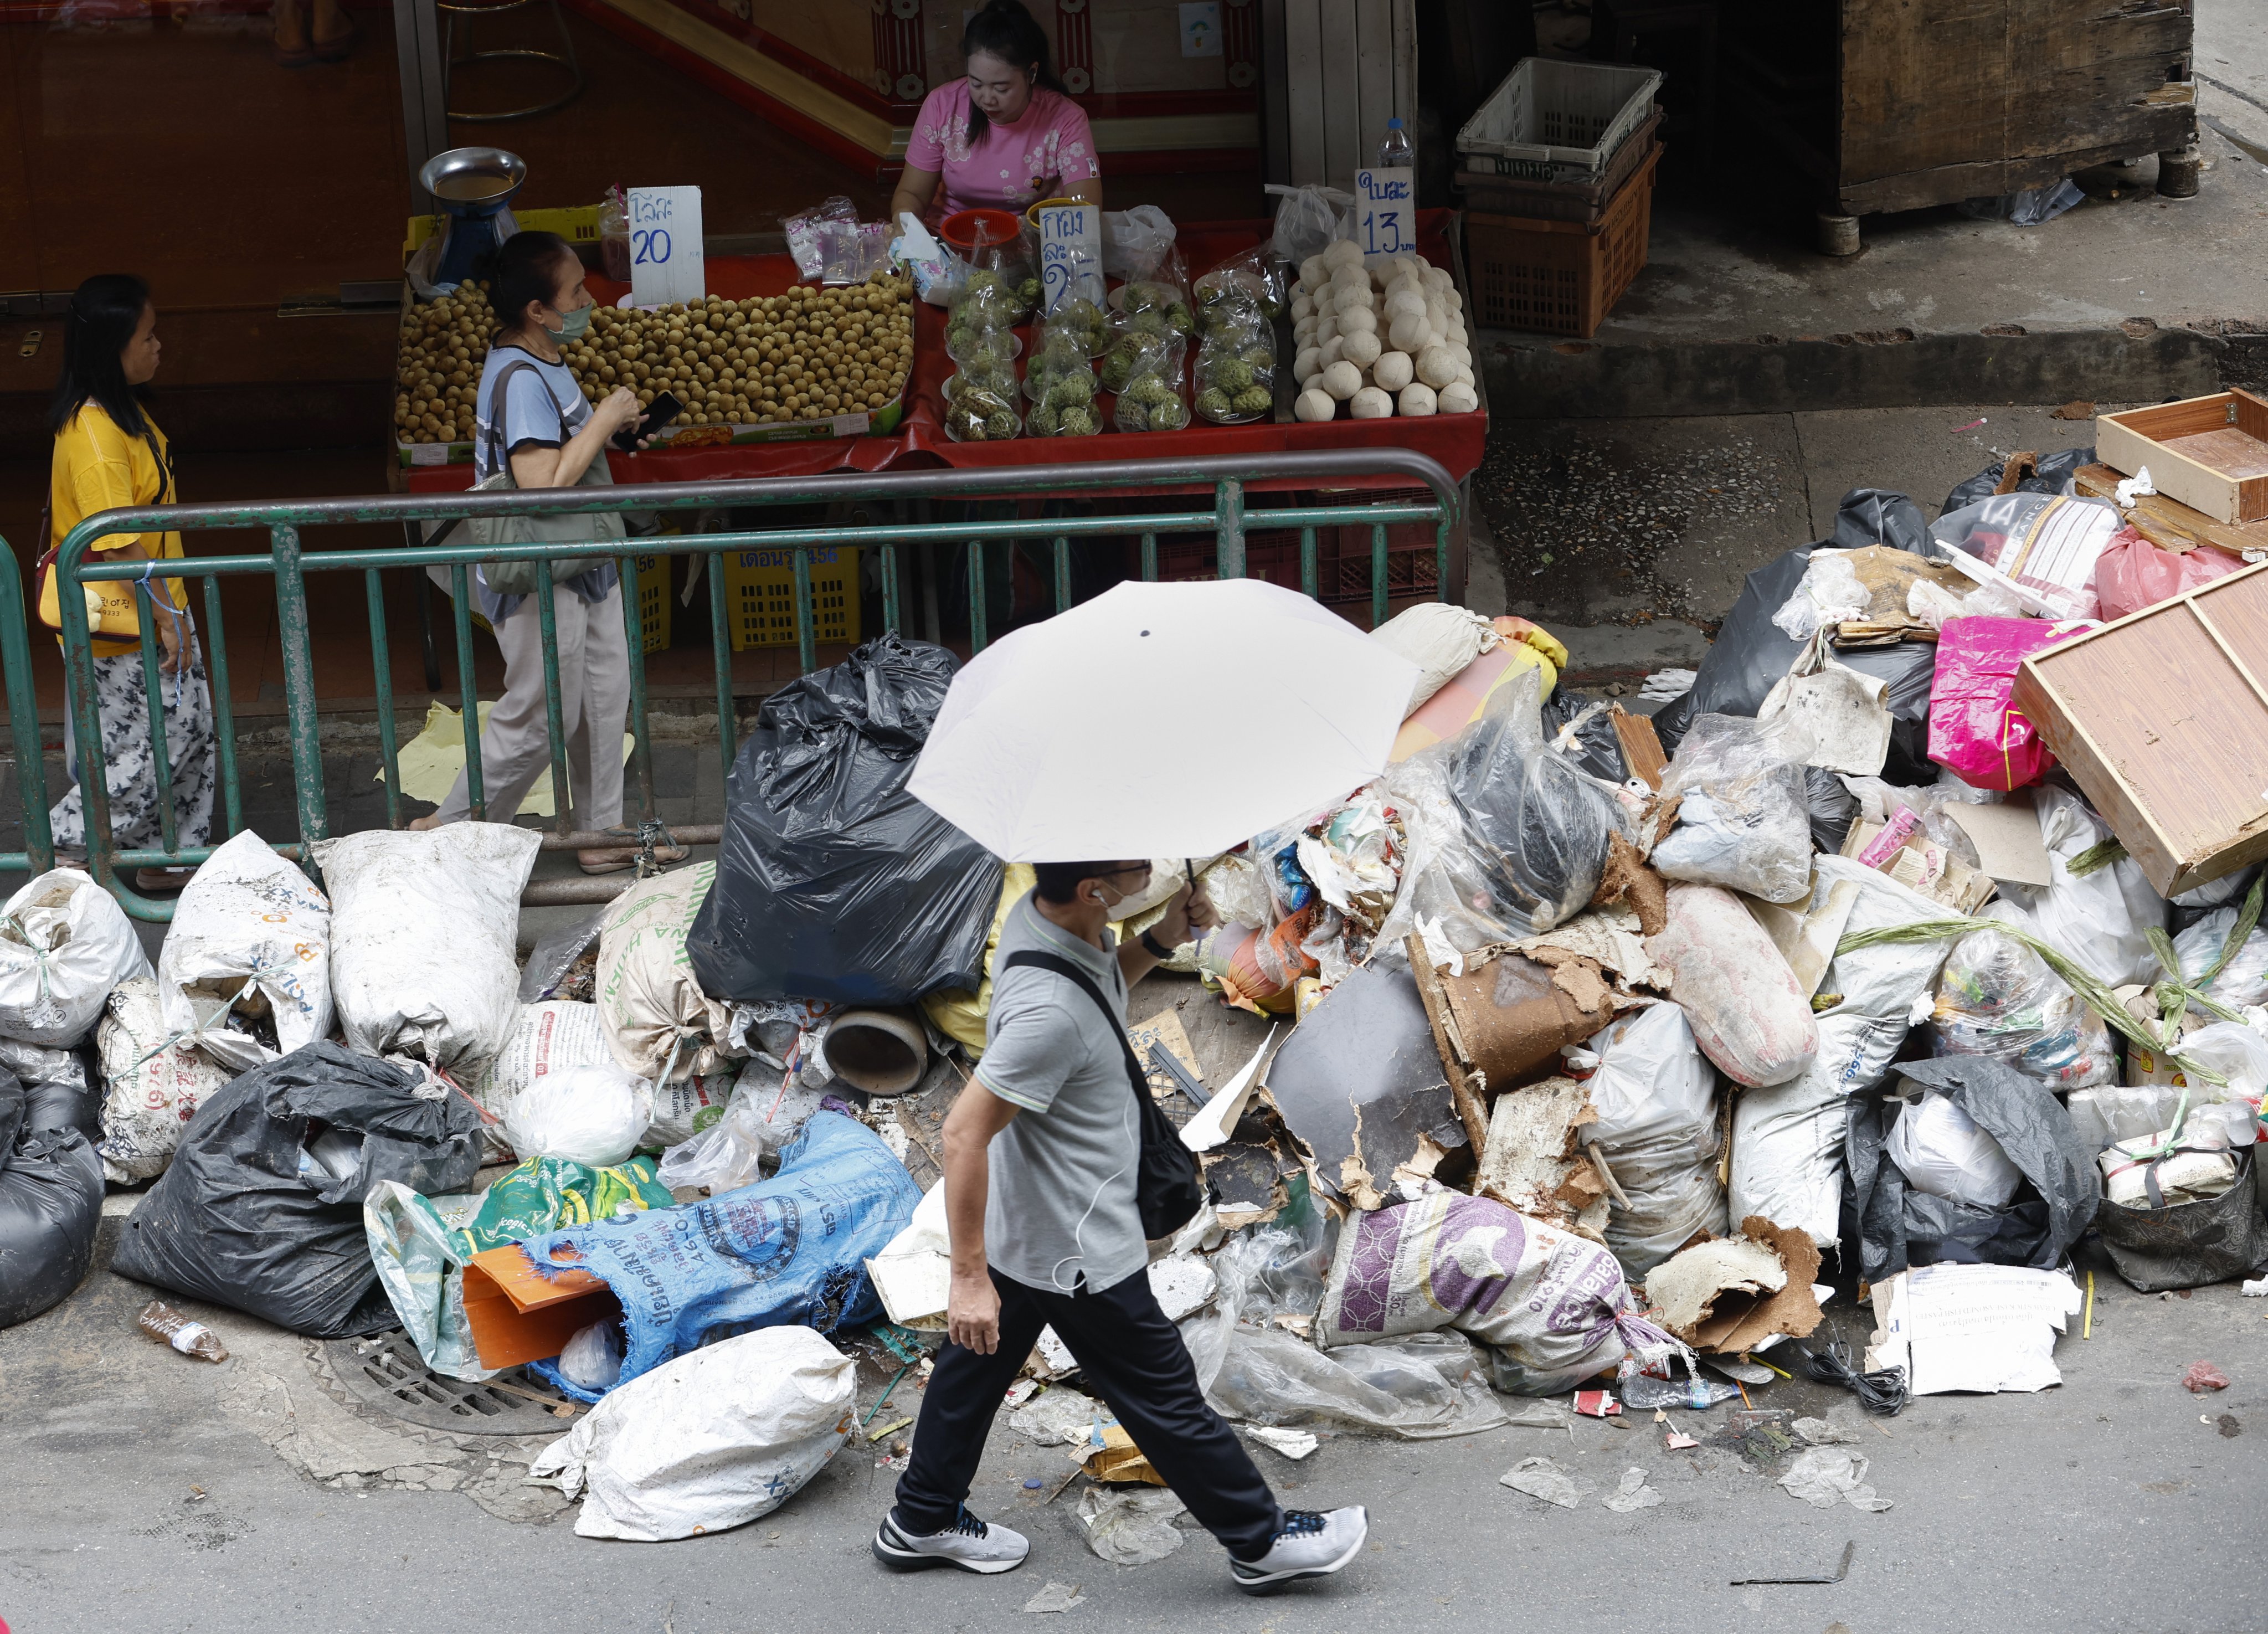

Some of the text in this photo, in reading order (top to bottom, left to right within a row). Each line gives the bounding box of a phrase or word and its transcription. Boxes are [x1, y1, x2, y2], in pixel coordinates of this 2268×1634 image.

[1359, 172, 1410, 201] ใบละ
[629, 192, 672, 223] โลละ
[1042, 210, 1083, 238] กอง
[1363, 211, 1399, 255] 13
[632, 229, 671, 265] 20
[1043, 243, 1067, 261] ละ
[1390, 1295, 1402, 1309] 30
